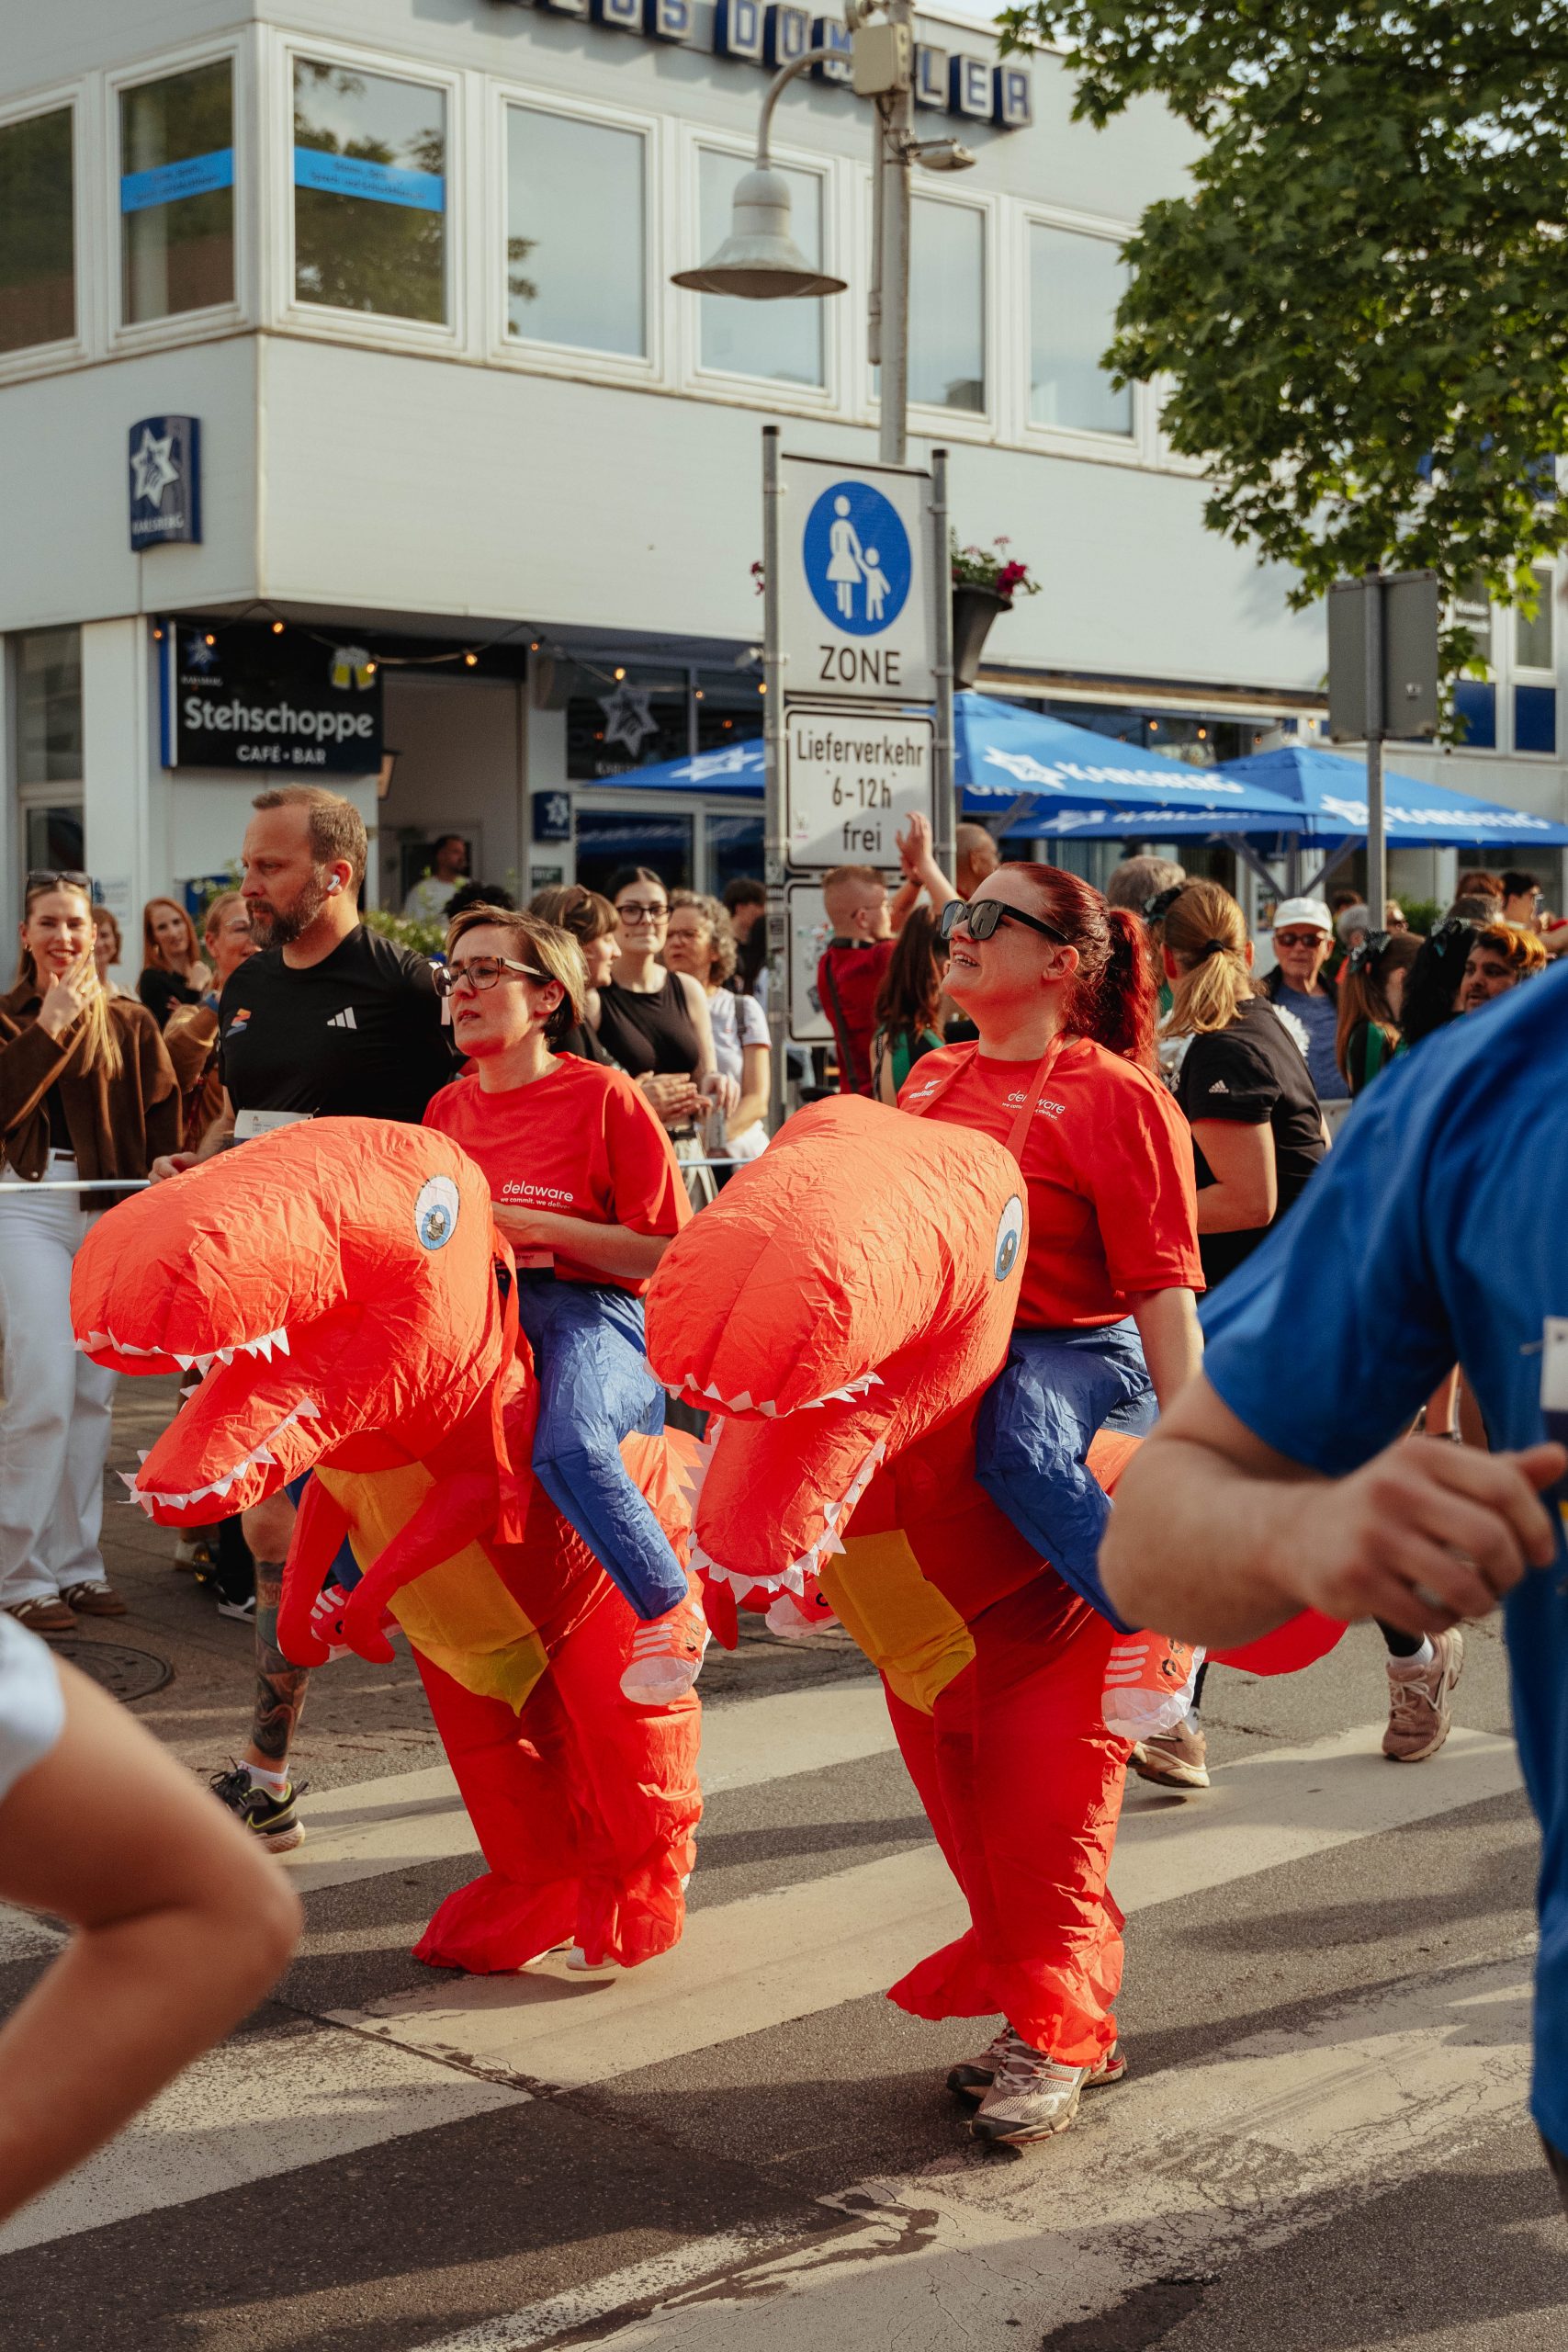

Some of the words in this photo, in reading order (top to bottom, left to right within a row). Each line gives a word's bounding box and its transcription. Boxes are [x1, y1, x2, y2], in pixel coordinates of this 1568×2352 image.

[819, 645, 901, 685] ZONE
[185, 695, 374, 742] Stehschoppe
[236, 744, 281, 763] CAFÉ
[291, 747, 326, 764] BAR
[796, 730, 924, 766] Lieferverkehr
[842, 821, 882, 853] frei
[1008, 1090, 1066, 1114] delware
[502, 1181, 574, 1202] delaware
